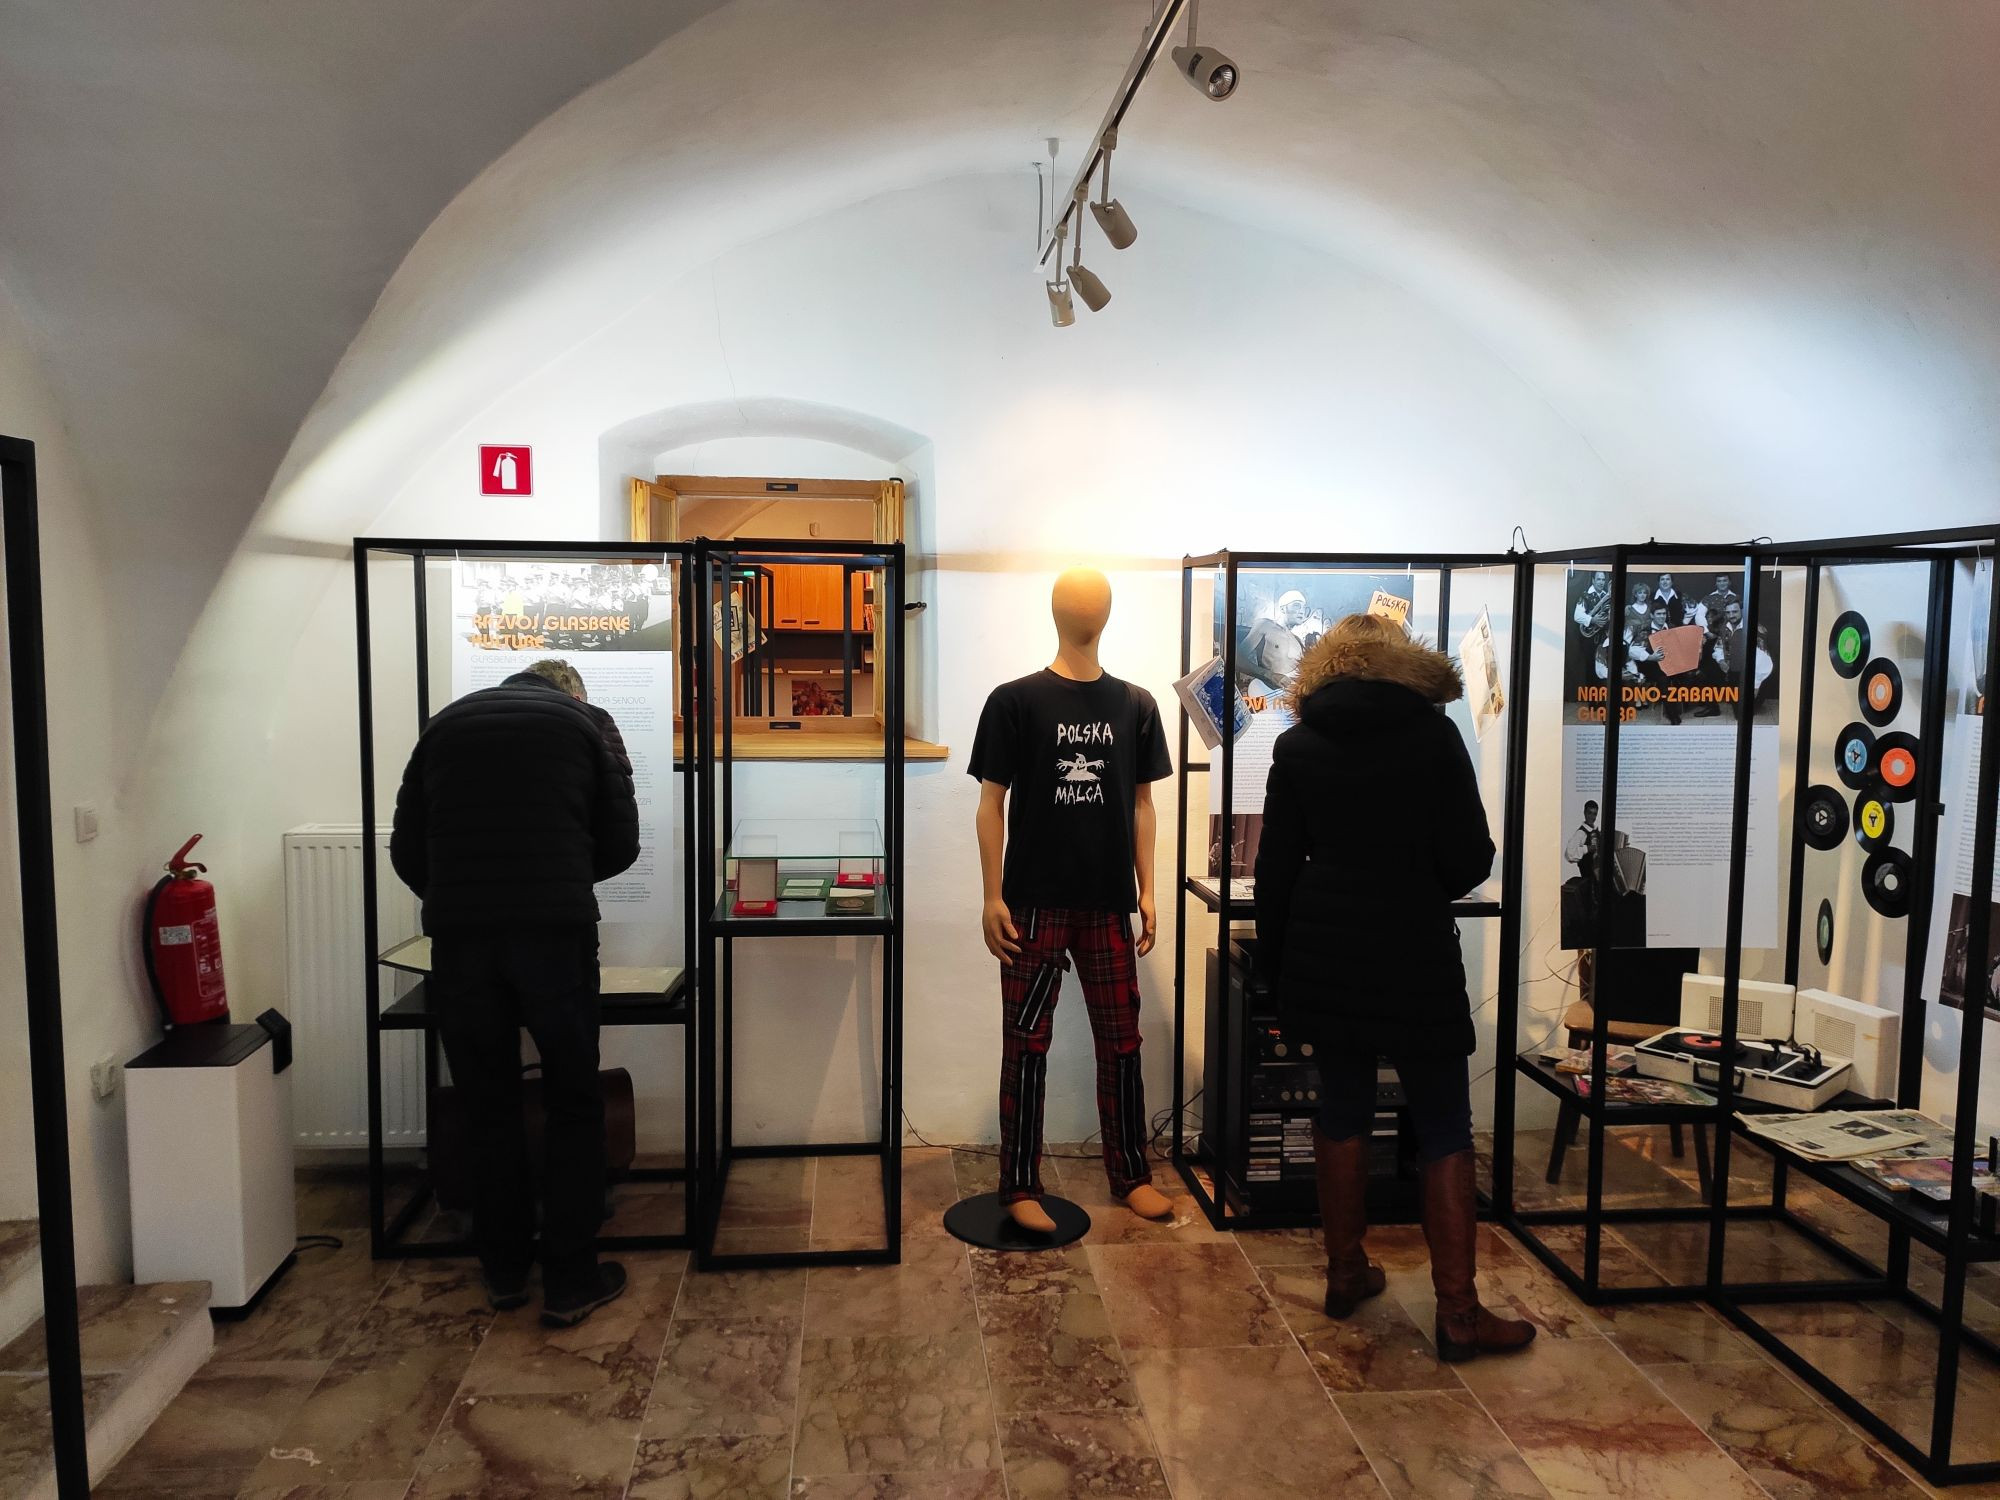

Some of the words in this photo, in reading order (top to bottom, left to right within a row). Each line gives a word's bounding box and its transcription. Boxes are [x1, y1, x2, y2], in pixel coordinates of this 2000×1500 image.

[1376, 594, 1407, 613] POLSKA
[472, 613, 540, 630] RAZVOJ
[544, 615, 630, 631] GLASBENE
[1577, 686, 1739, 703] NARDNO-ZABAVN
[1577, 706, 1638, 722] GLABA
[1057, 721, 1114, 746] POLSKA
[1055, 783, 1104, 805] MALCA
